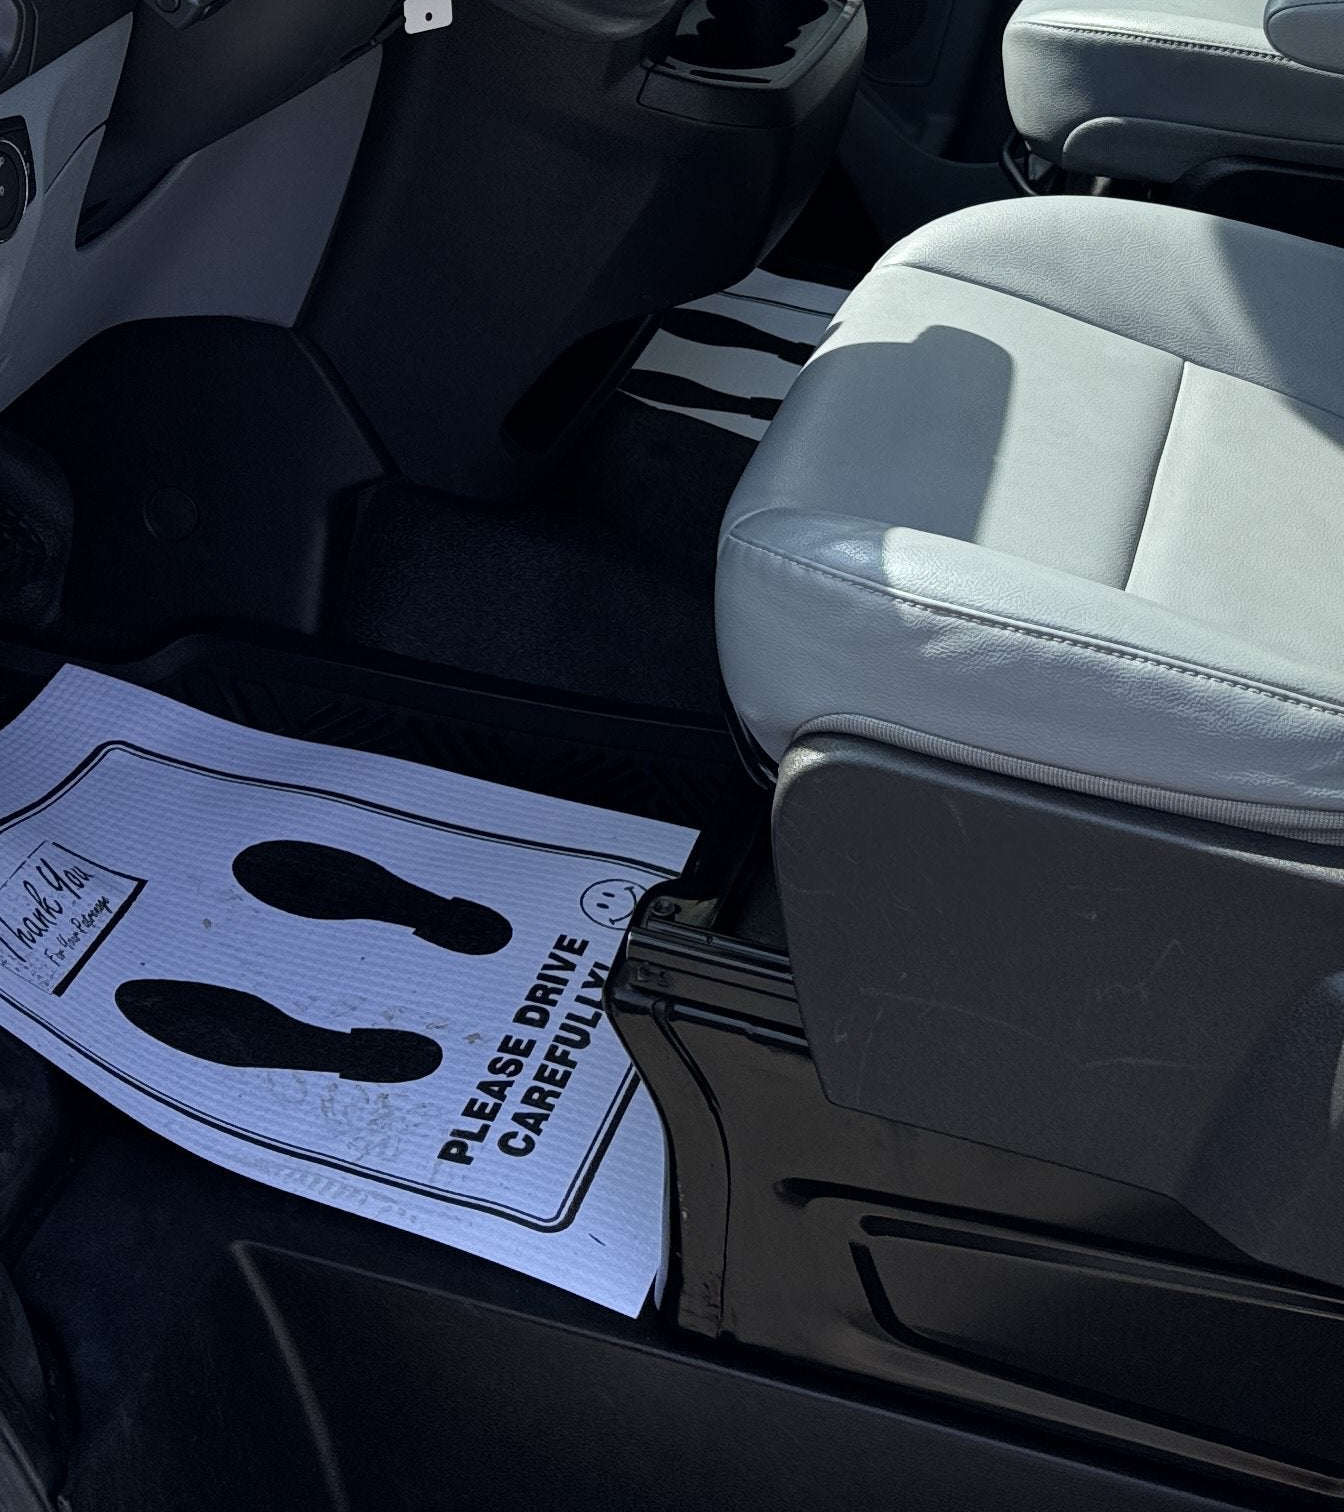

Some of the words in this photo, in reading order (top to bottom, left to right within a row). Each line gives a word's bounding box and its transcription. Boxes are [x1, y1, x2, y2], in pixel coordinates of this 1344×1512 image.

[35, 857, 96, 900] You
[437, 1034, 537, 1166] PLEASE
[512, 933, 590, 1029] DRIVE
